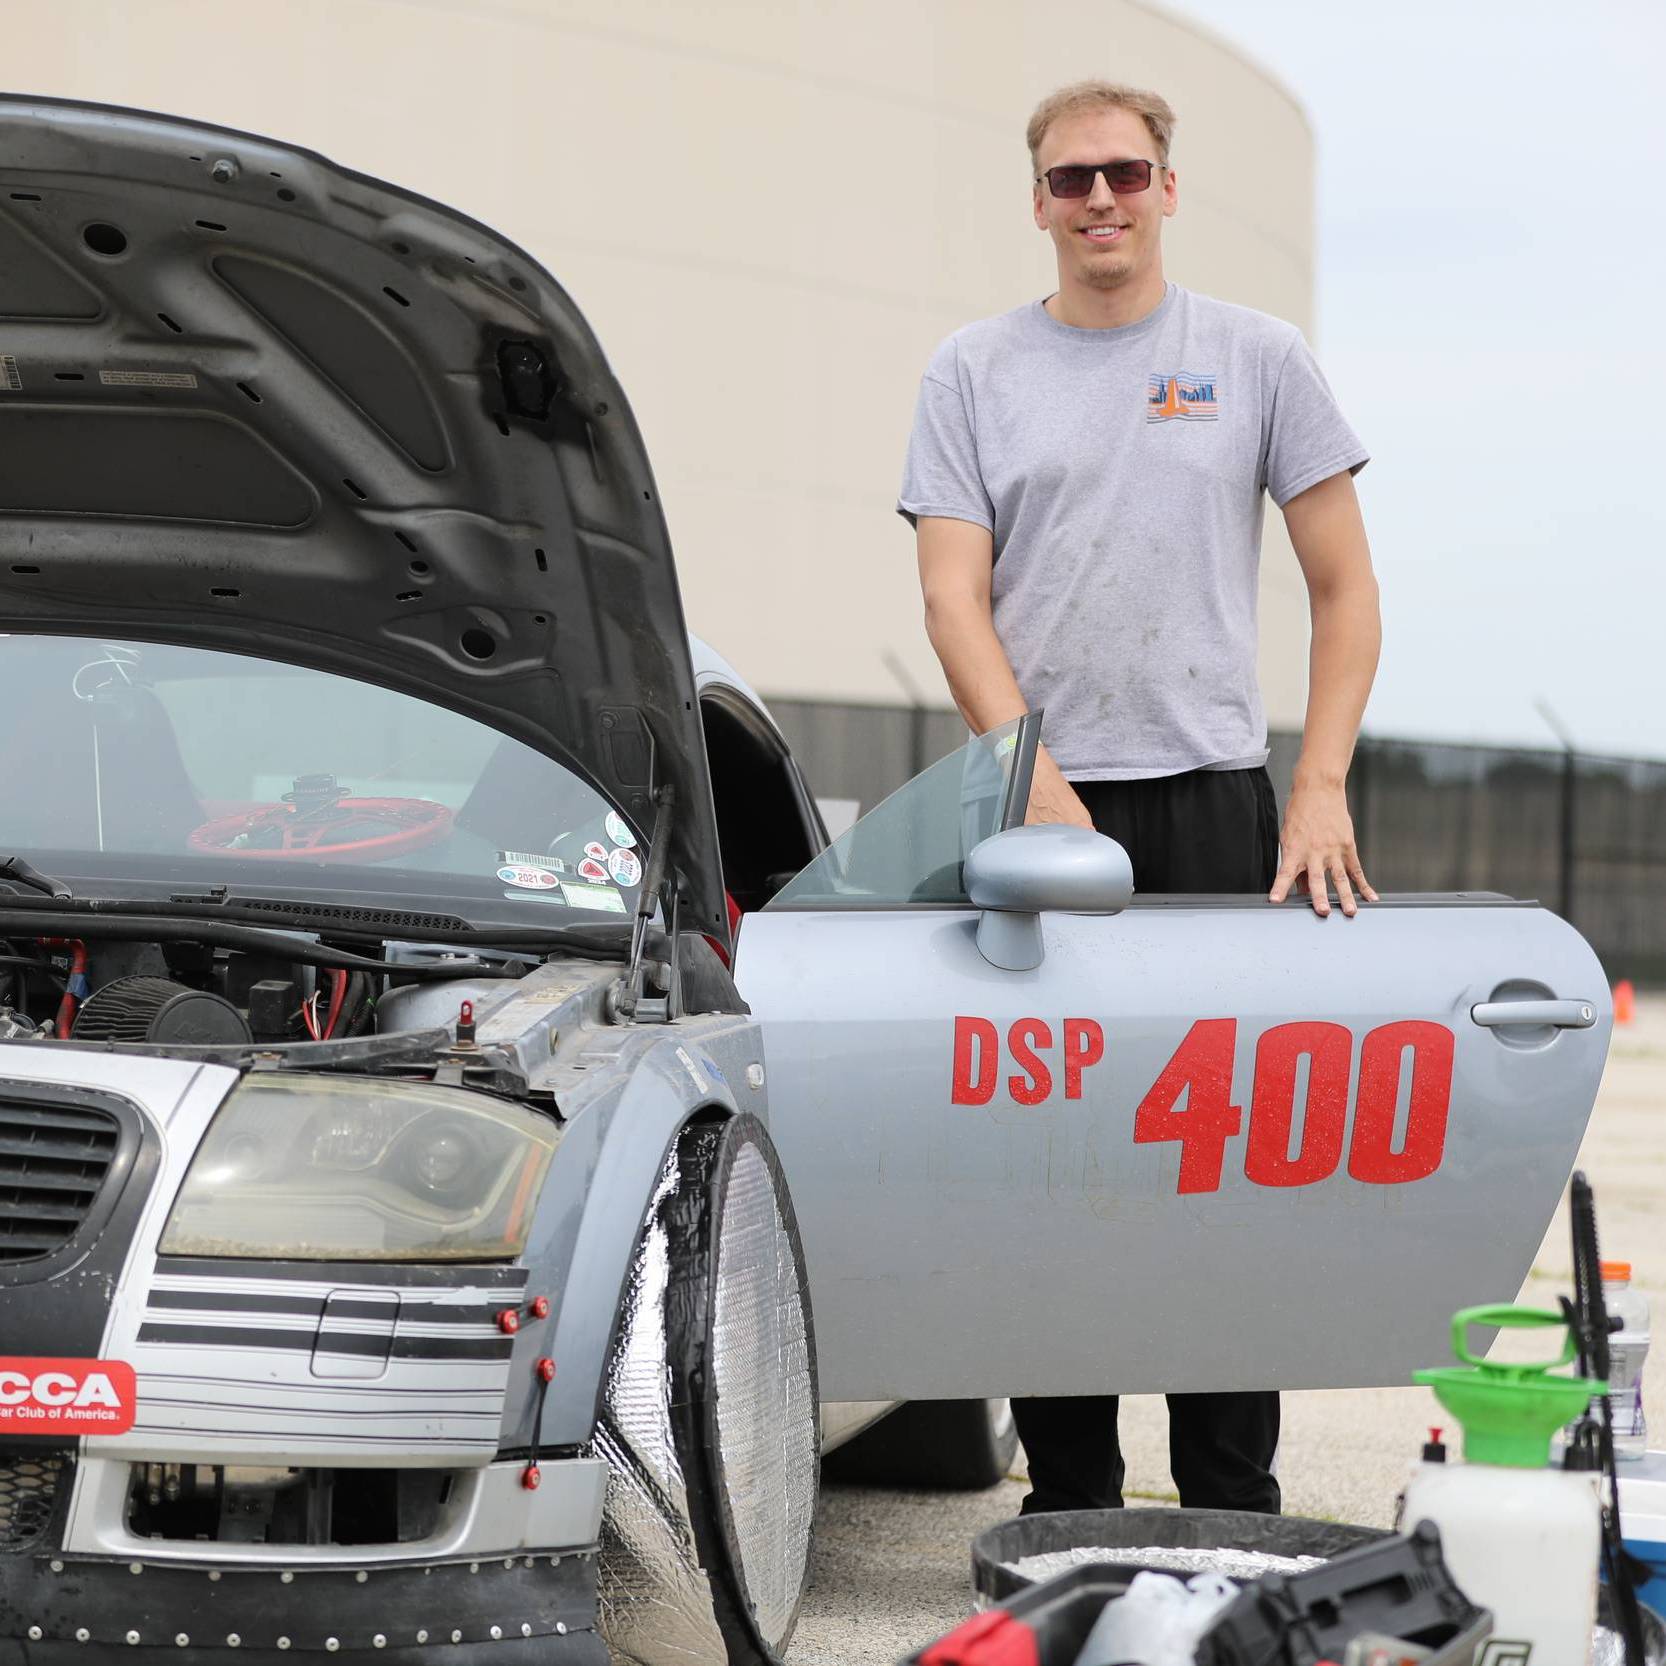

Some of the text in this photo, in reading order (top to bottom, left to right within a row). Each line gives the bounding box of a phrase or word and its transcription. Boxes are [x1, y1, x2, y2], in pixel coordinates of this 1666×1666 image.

[517, 872, 538, 883] 2021
[952, 1016, 1455, 1195] DSP 400
[0, 1407, 14, 1418] ar
[16, 1406, 46, 1419] Club
[48, 1408, 61, 1419] of
